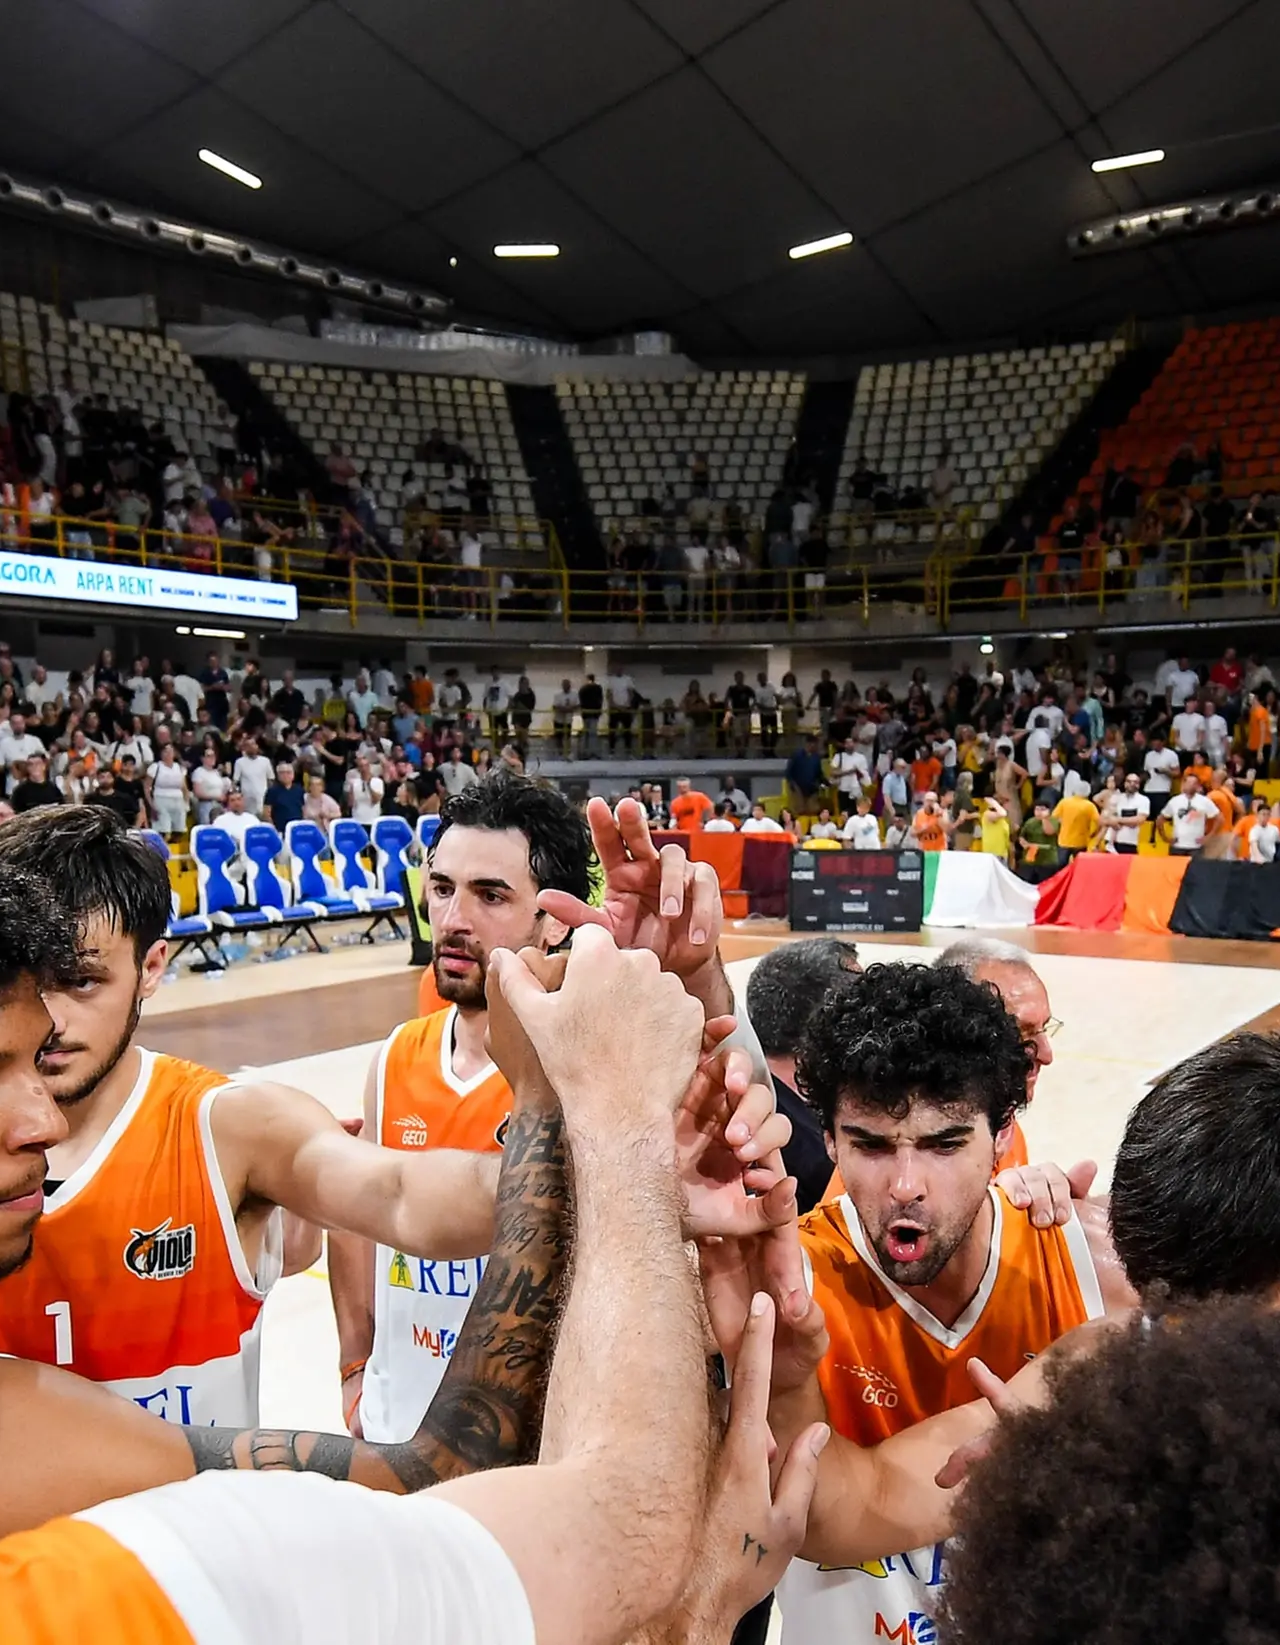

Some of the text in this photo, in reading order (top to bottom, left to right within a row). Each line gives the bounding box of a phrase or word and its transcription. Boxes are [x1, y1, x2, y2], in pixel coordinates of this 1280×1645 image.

[76, 571, 154, 597] ARPA RENT
[402, 1130, 427, 1146] GECO
[147, 1231, 192, 1272] VIOLA
[46, 1301, 73, 1364] 1
